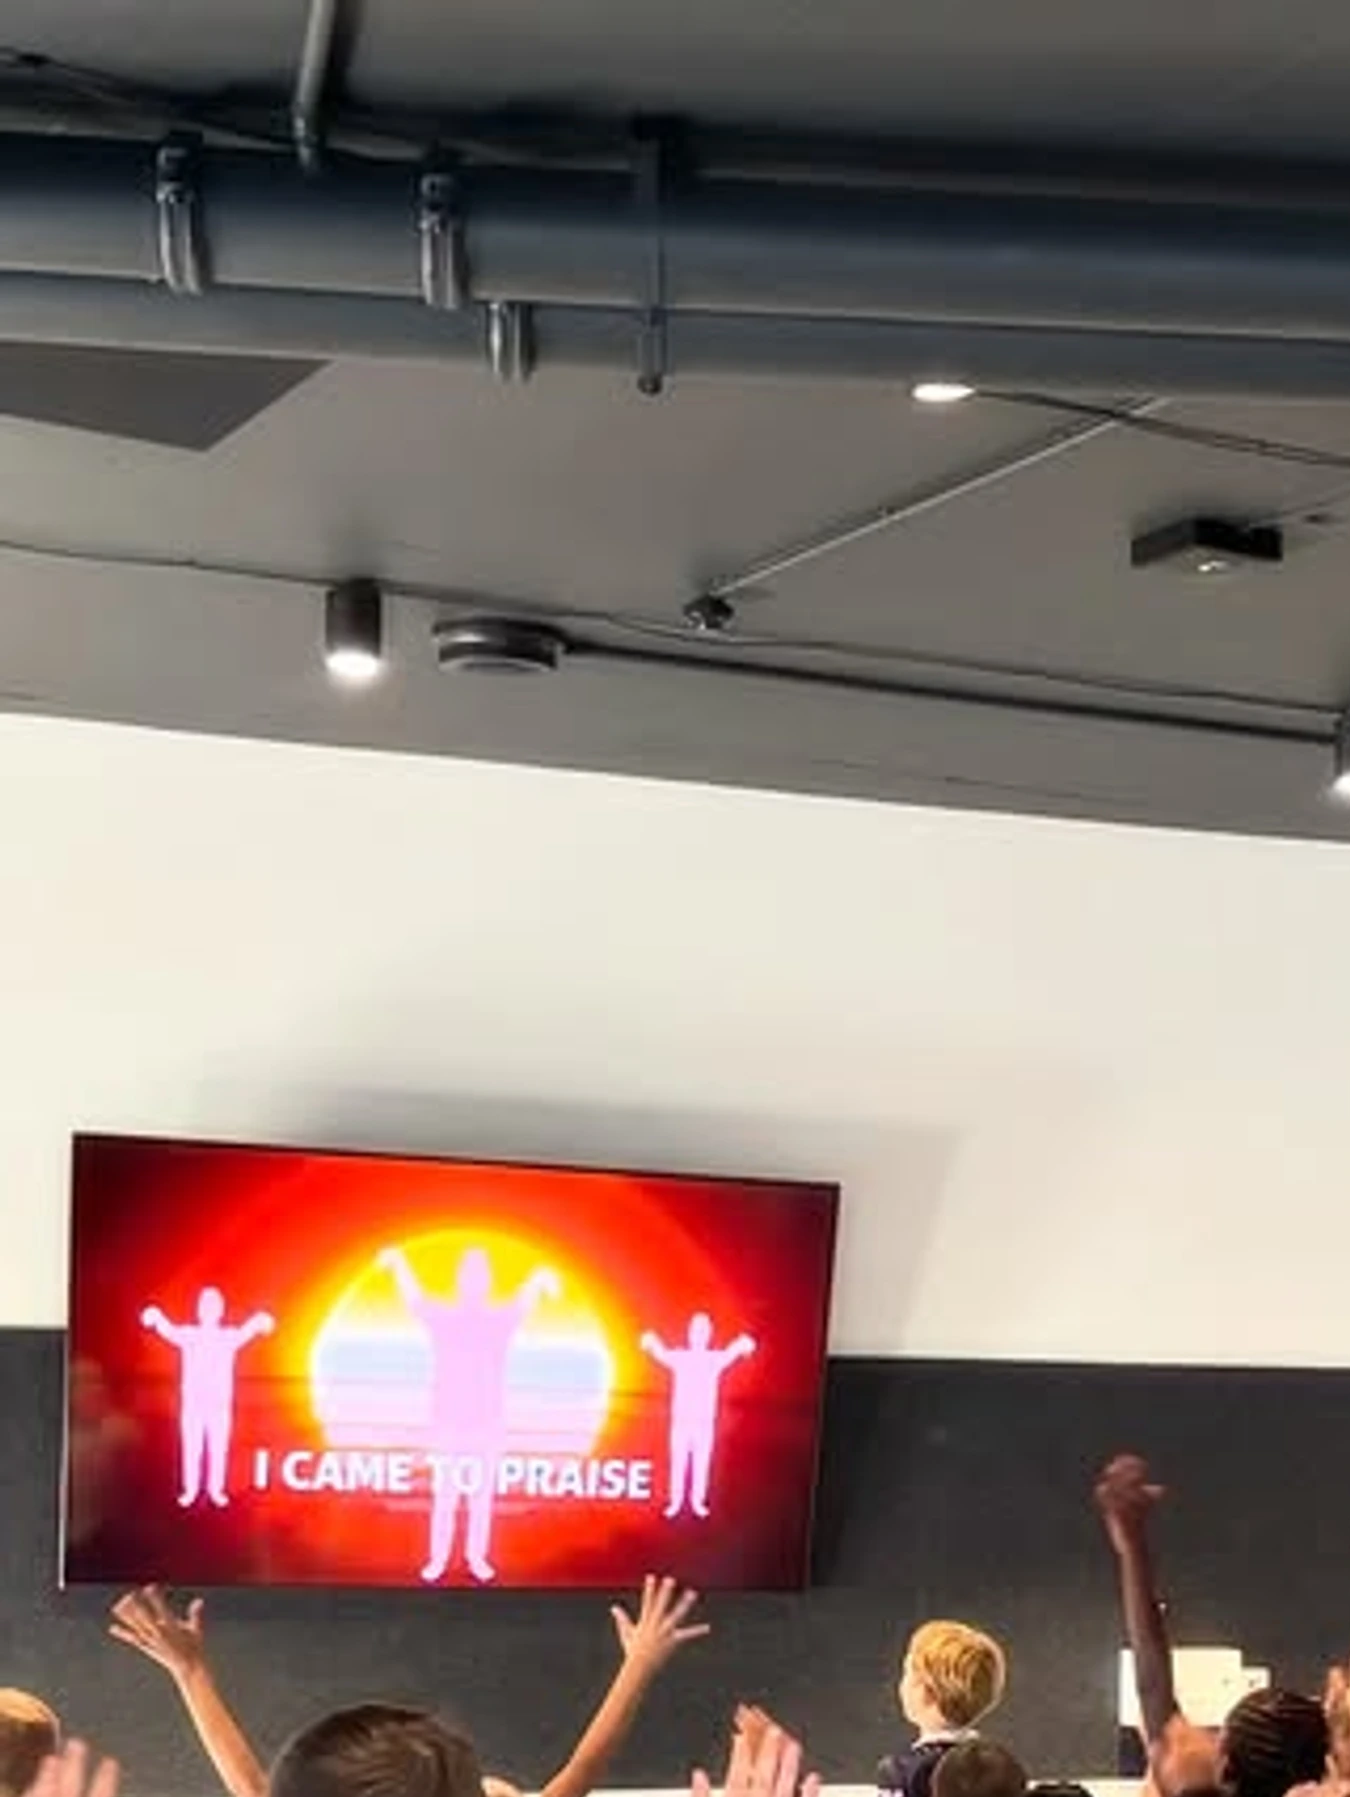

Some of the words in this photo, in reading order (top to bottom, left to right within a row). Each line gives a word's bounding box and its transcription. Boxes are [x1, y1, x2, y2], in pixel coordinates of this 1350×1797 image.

[254, 1450, 269, 1490] I
[281, 1450, 412, 1493] CAME
[426, 1454, 484, 1496] TO
[500, 1456, 652, 1499] PRAISE
